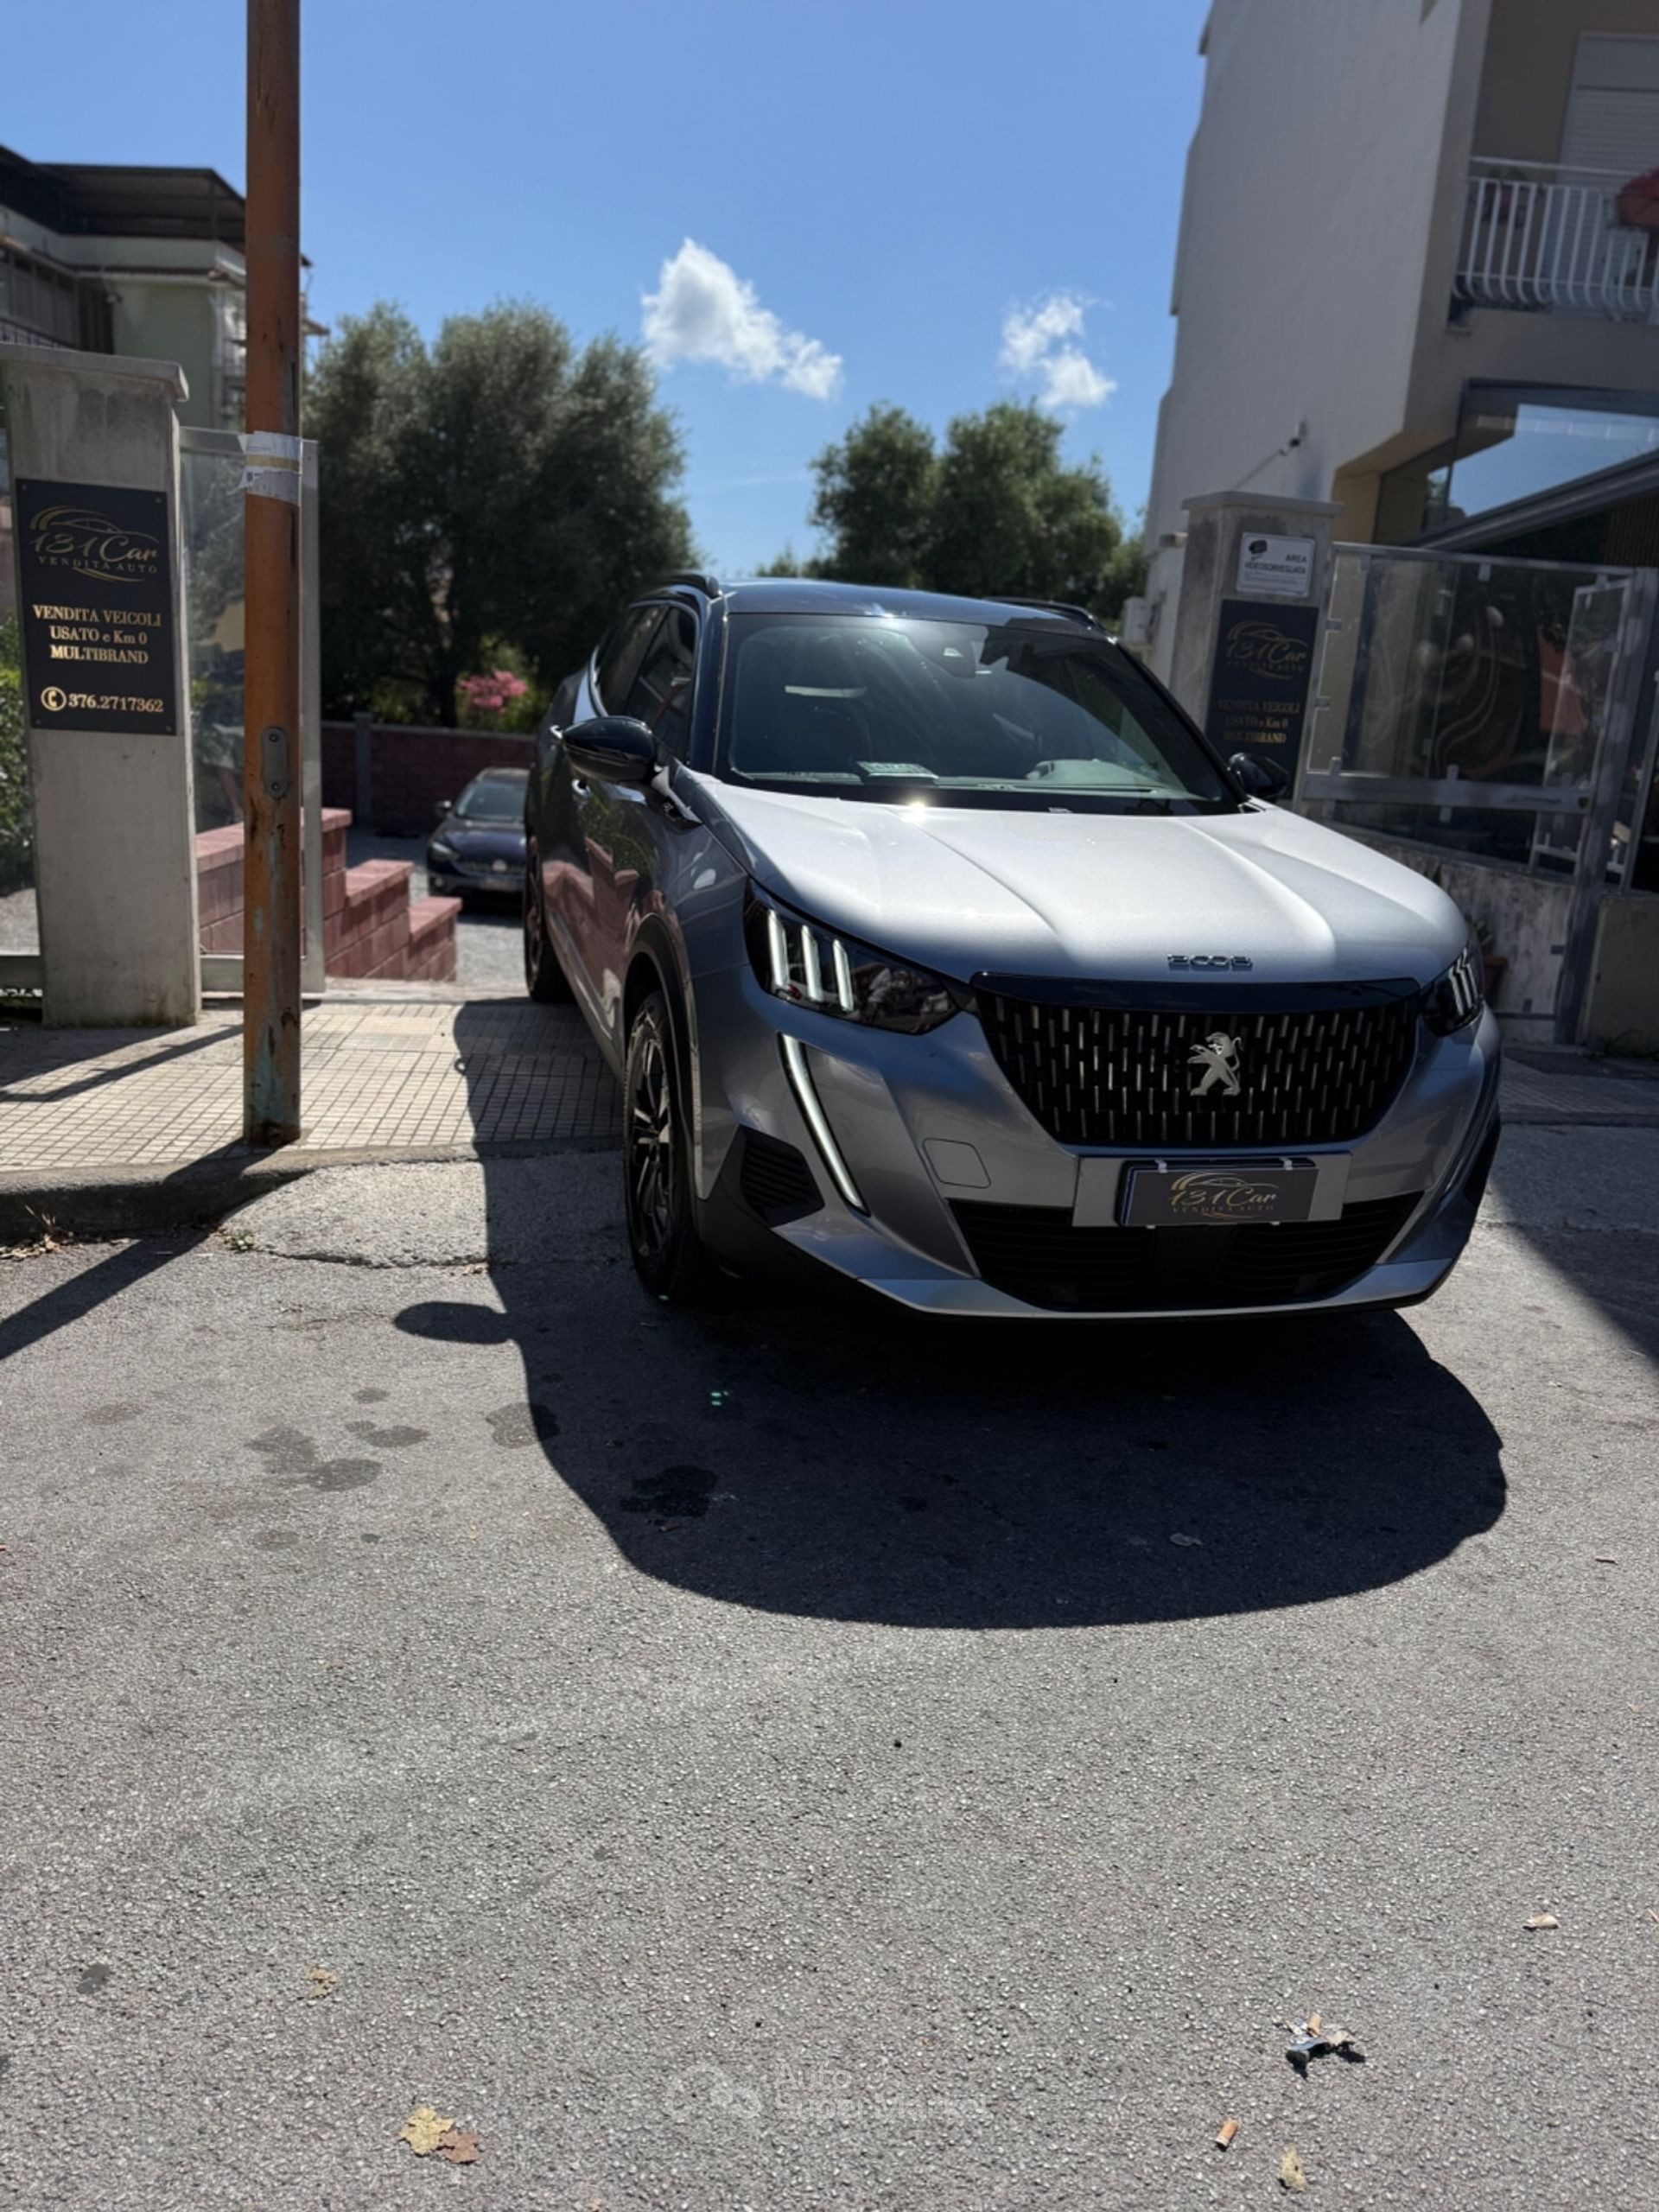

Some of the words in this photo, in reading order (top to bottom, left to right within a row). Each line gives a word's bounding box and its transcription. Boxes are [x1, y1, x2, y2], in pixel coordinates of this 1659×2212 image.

[38, 556, 111, 570] VENDITA
[116, 562, 158, 575] AUTO
[1285, 553, 1307, 563] AREA
[33, 604, 99, 623] VENDITA
[103, 609, 162, 626] VEICOLI
[49, 626, 99, 642] USATO
[102, 633, 110, 643] e
[113, 630, 135, 644] Km
[138, 632, 148, 645] 0
[49, 645, 149, 664] MULTIBRAND
[68, 694, 163, 713] 376.2717362
[1167, 954, 1253, 969] 2008
